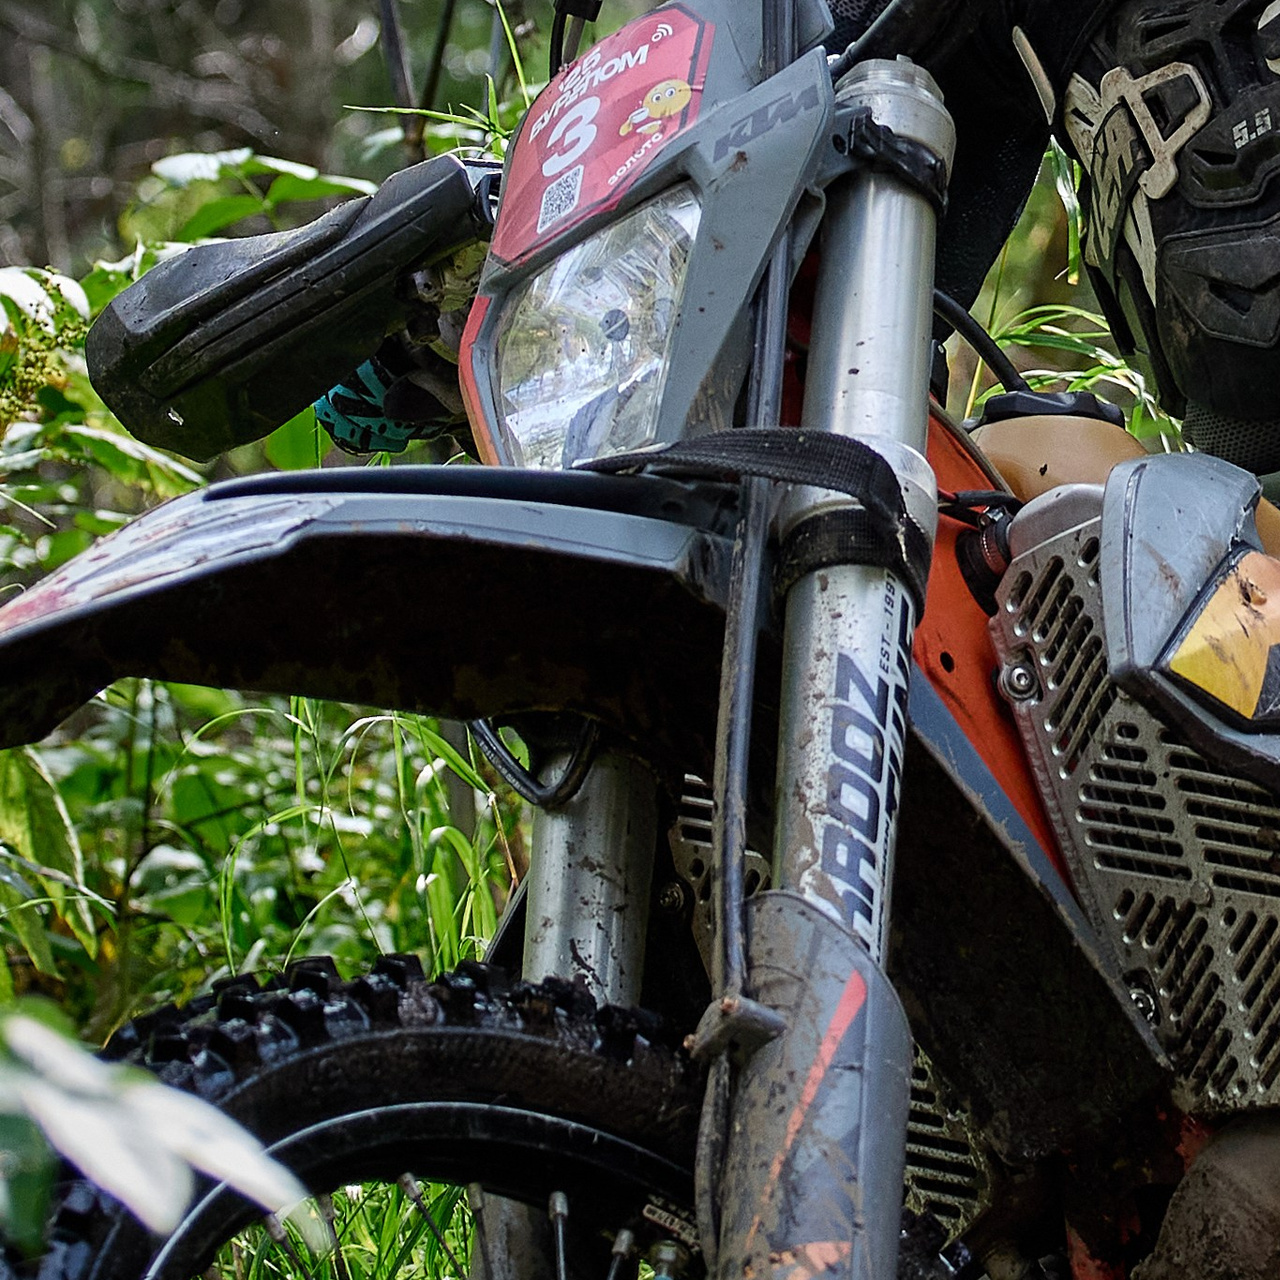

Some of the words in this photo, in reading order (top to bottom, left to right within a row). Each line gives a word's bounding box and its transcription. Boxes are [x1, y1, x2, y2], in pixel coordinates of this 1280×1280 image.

[541, 96, 601, 177] 3
[713, 84, 820, 163] KTM
[884, 571, 897, 617] 1991
[879, 633, 891, 675] EST
